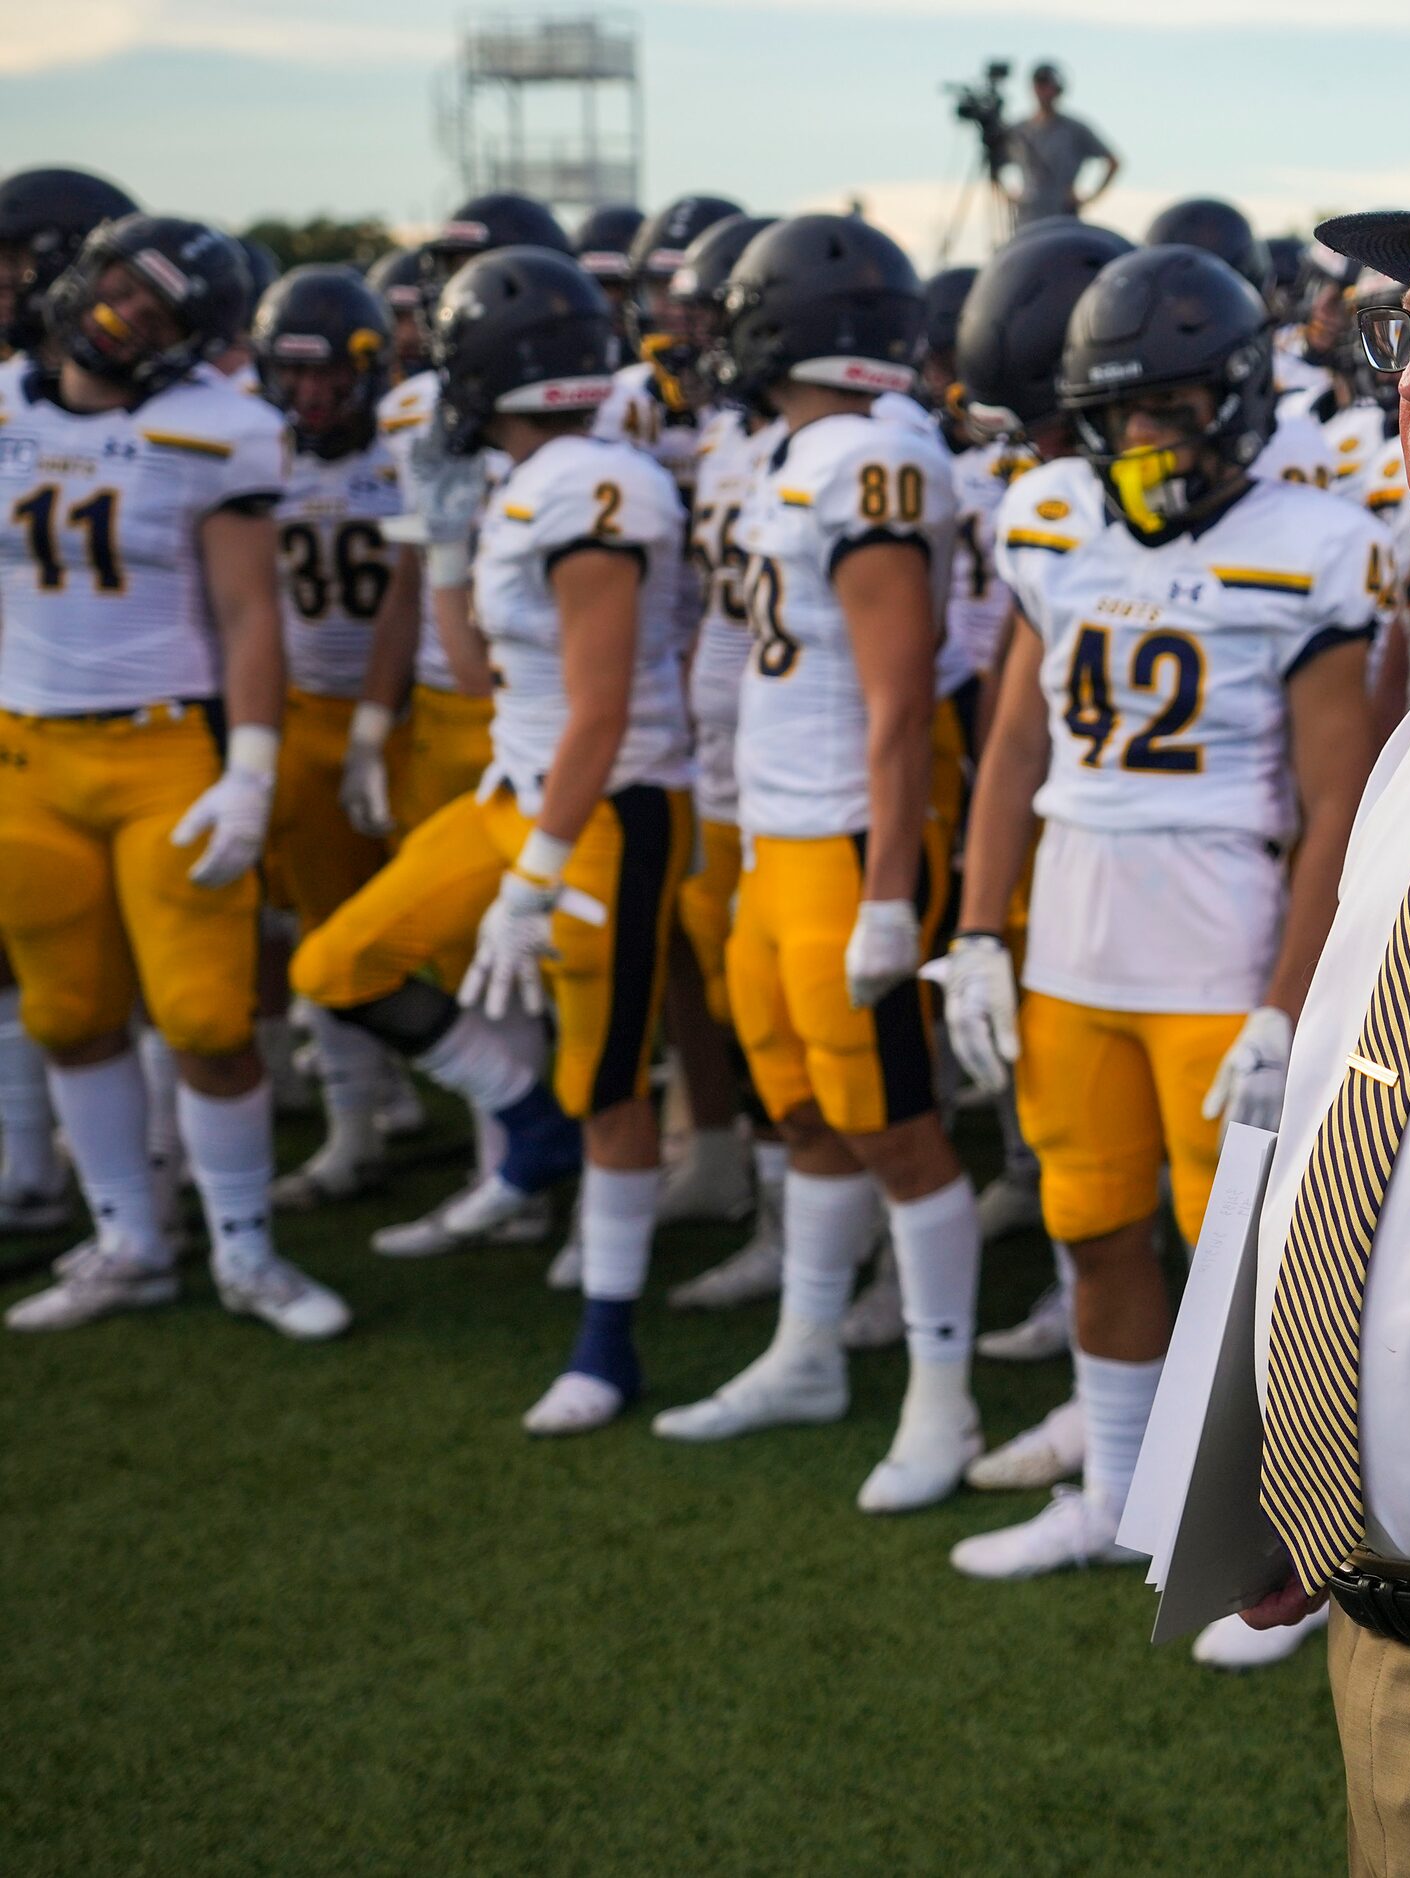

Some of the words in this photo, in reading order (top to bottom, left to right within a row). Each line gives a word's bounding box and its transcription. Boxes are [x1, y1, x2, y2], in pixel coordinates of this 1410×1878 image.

[11, 481, 127, 593] 11
[591, 482, 623, 537] 2
[858, 463, 926, 526] 80
[281, 519, 390, 621] 36
[1063, 623, 1207, 776] 42
